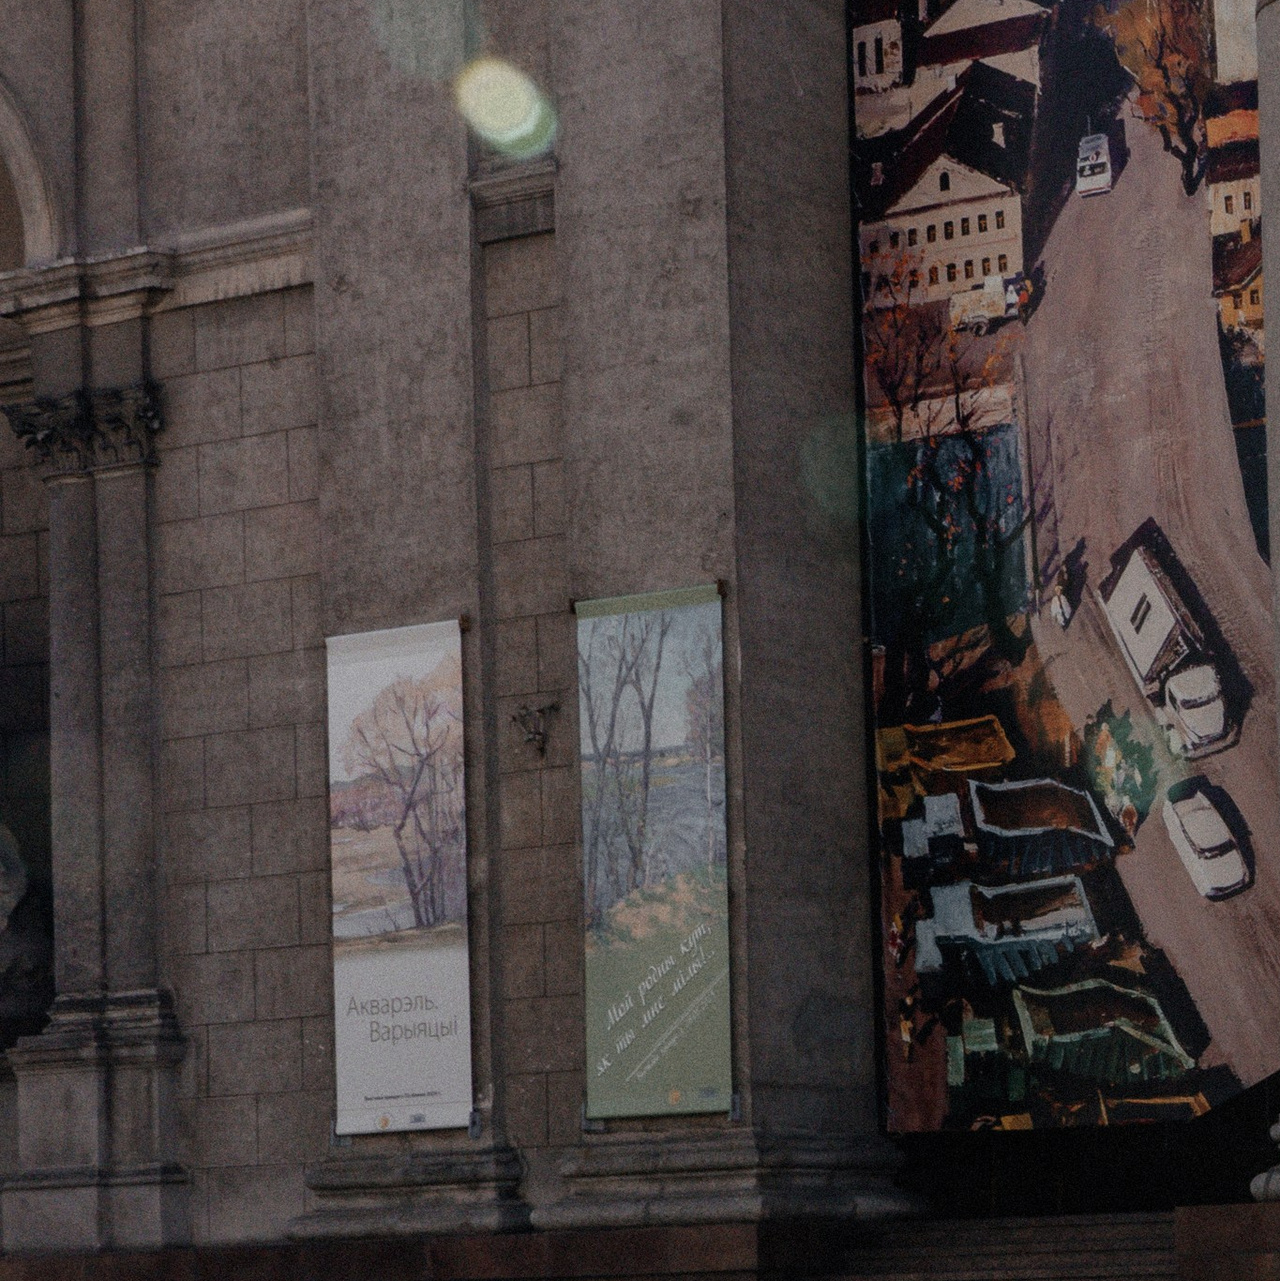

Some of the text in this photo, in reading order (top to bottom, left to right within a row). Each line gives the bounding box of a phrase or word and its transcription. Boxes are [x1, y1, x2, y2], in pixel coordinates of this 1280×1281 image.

[346, 995, 439, 1018] Акварэль.
[607, 991, 634, 1031] Мой
[638, 955, 676, 1006] родны
[370, 1015, 458, 1046] Варыяцыі
[615, 1028, 636, 1054] ты
